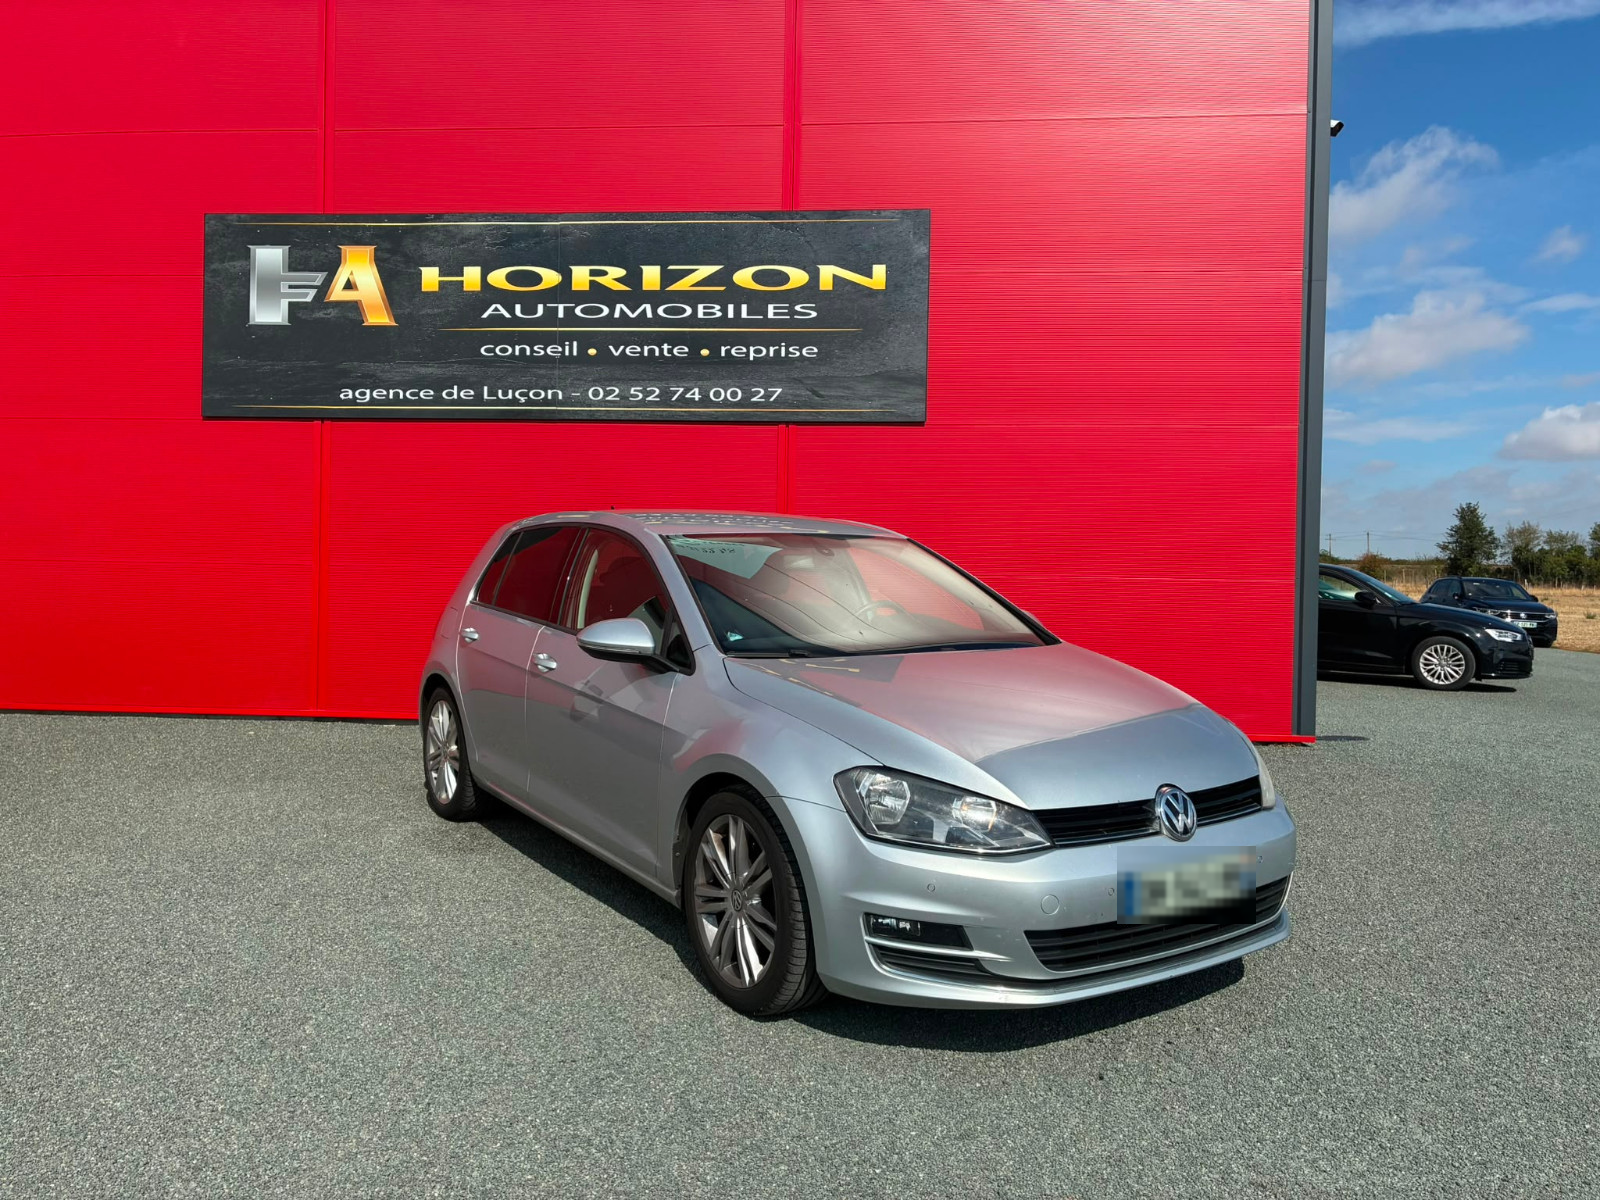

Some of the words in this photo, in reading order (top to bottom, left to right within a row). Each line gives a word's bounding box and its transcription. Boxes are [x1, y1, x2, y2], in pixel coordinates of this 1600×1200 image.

[418, 264, 887, 292] HORIZON
[481, 303, 818, 319] AUTOMOBILES
[480, 340, 578, 357] conseil
[608, 344, 689, 357] vente
[720, 341, 819, 361] reprise
[339, 387, 435, 403] agence
[441, 385, 475, 400] de
[483, 386, 563, 404] Luçon
[588, 386, 620, 401] 02
[629, 386, 661, 401] 52
[669, 386, 702, 402] 74
[709, 387, 742, 402] 00
[750, 387, 783, 402] 27
